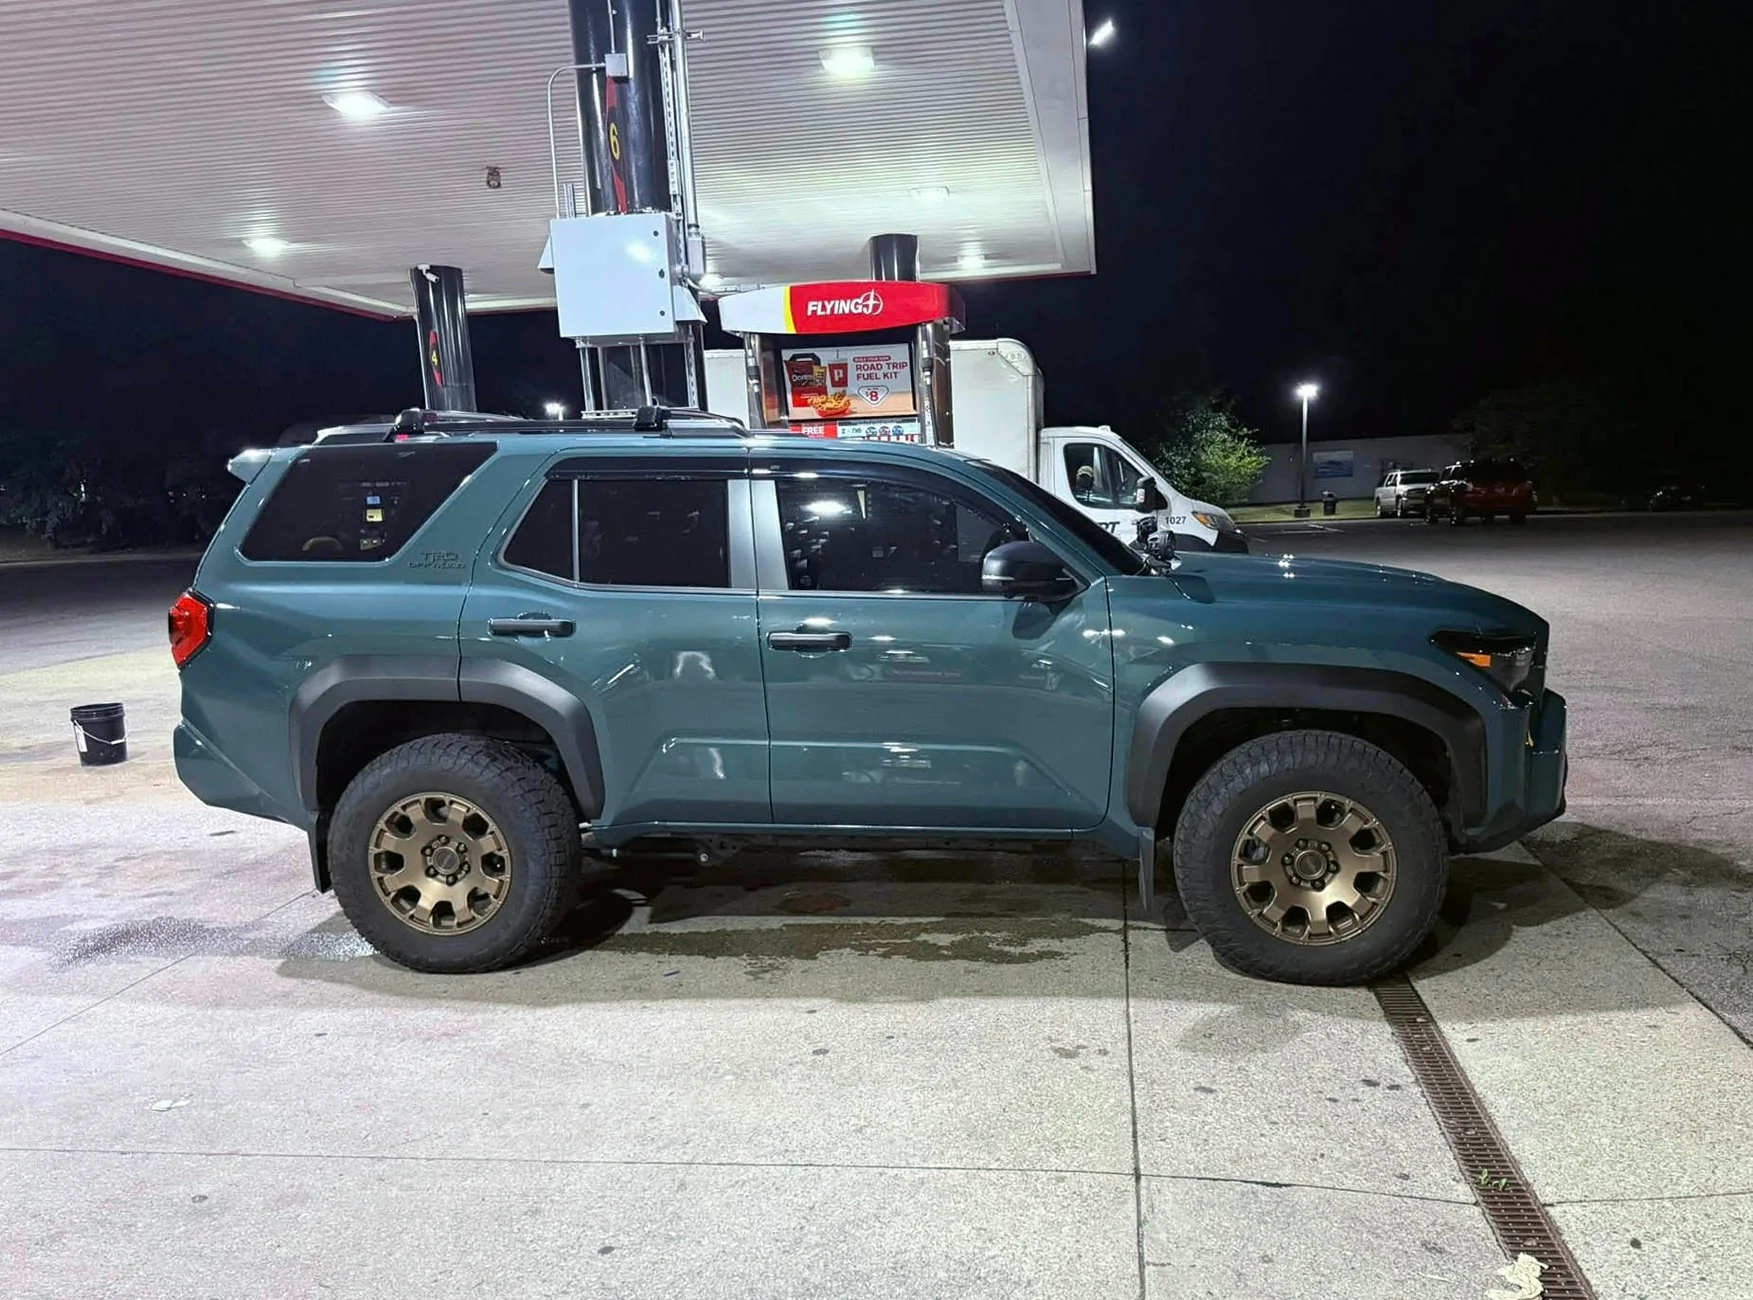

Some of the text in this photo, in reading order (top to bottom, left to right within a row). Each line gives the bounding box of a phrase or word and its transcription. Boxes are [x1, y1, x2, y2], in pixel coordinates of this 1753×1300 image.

[610, 122, 620, 160] 6
[432, 350, 439, 366] 4
[856, 362, 908, 372] ROAD TRIP
[856, 372, 899, 381] FUEL KIT
[801, 426, 825, 435] FREE
[1165, 517, 1187, 525] 1027
